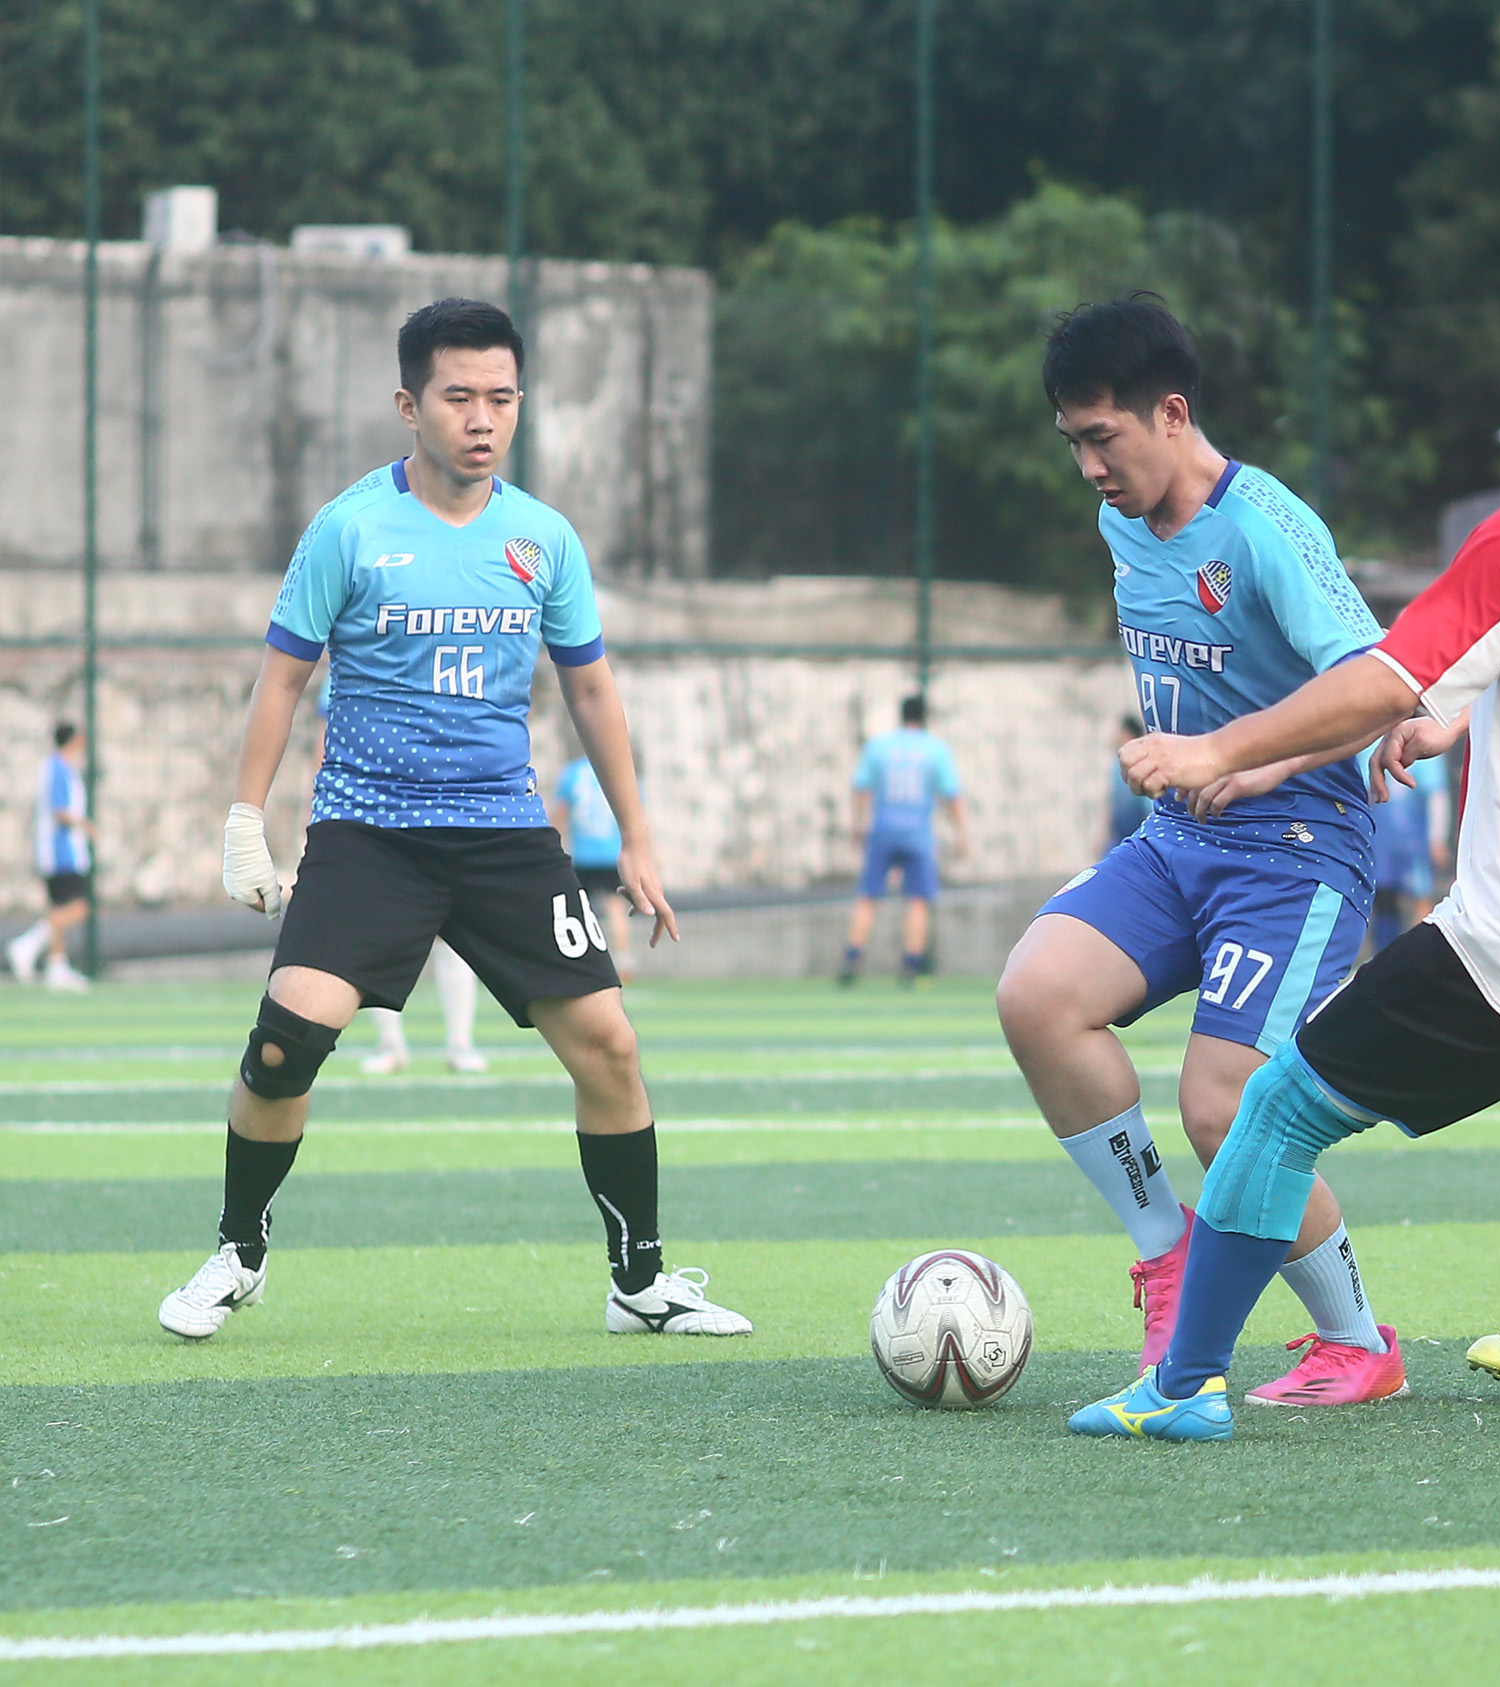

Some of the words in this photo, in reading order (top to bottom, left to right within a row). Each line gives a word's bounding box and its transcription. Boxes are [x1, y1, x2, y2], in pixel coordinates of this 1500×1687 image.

[376, 603, 538, 635] Forever
[433, 645, 485, 700] 66
[1140, 672, 1181, 735] 97
[551, 888, 608, 959] 66
[1201, 942, 1274, 1010] 97
[988, 1347, 1003, 1361] 5
